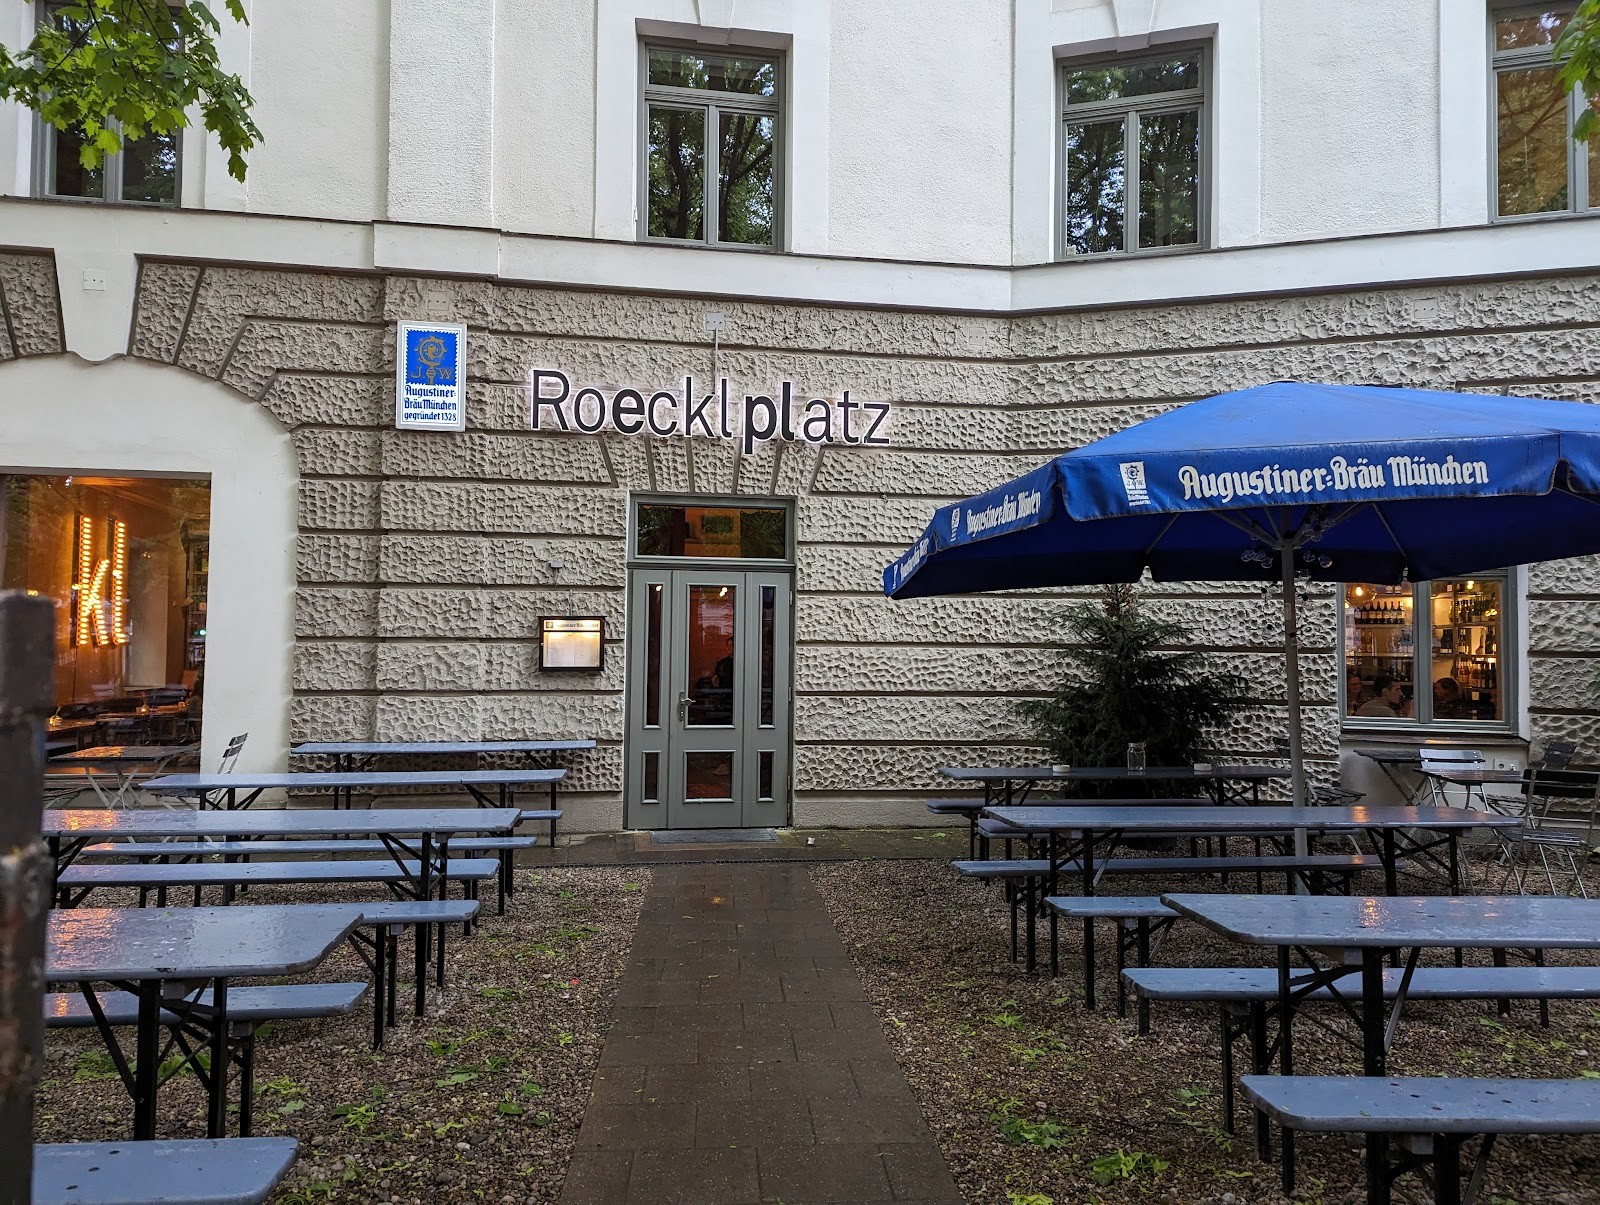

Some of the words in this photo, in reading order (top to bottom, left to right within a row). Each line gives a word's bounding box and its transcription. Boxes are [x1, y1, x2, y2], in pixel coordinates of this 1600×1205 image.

[404, 397, 422, 410] Bräu
[422, 399, 457, 411] München
[531, 369, 891, 454] Roecklplatz
[404, 411, 440, 421] gegründet
[441, 412, 457, 422] 1328
[1387, 455, 1489, 487] München
